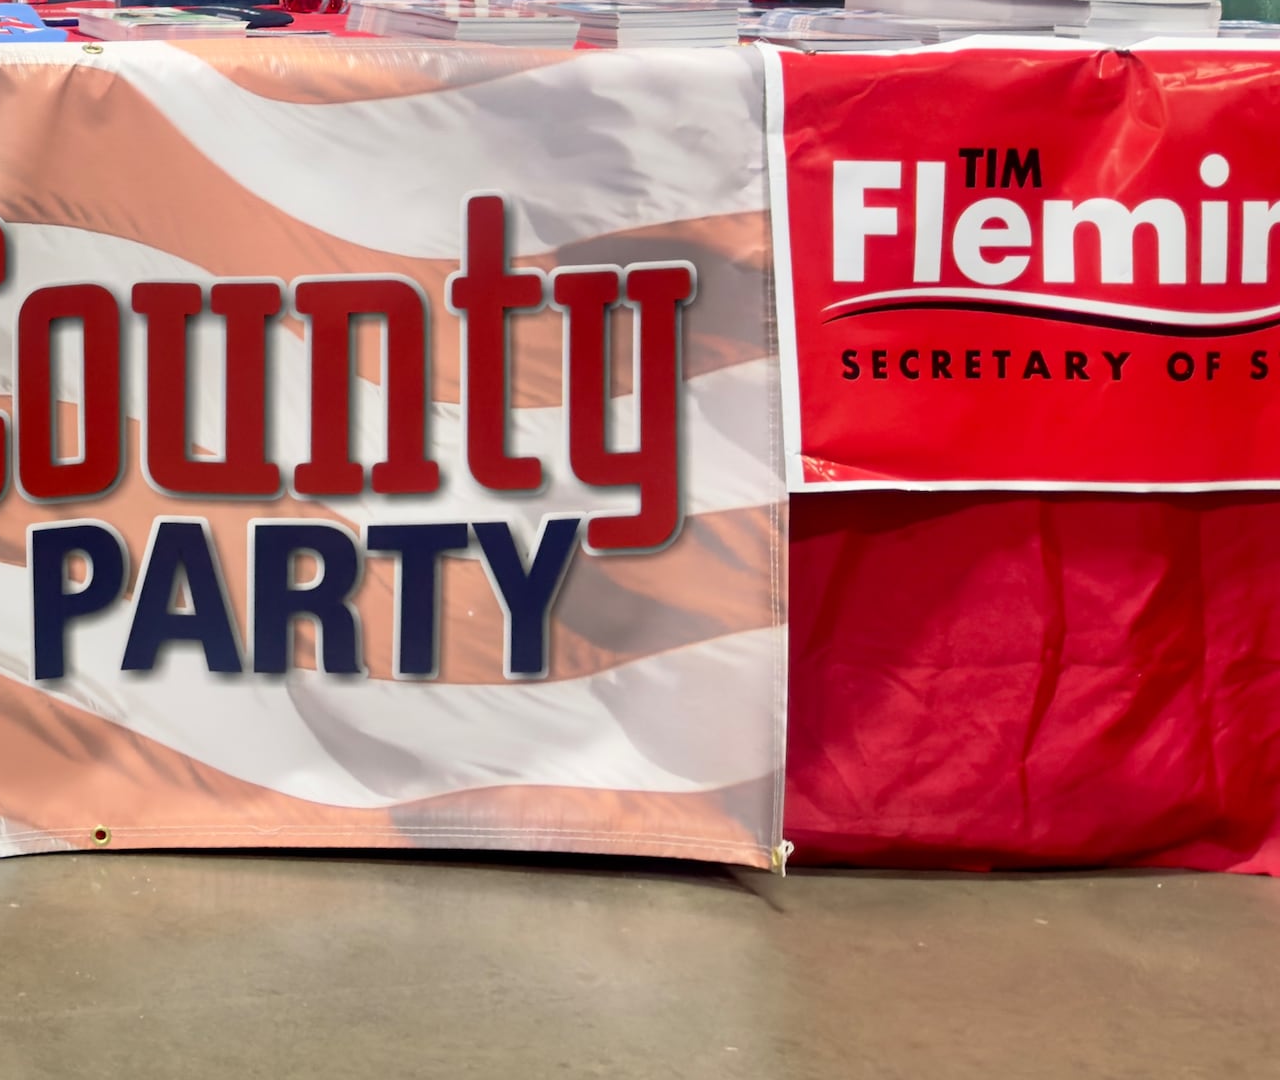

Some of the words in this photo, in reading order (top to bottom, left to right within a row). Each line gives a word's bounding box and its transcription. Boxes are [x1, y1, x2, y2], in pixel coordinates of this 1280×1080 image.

[958, 147, 1042, 189] TIM
[841, 349, 1133, 381] SECRETARY
[1165, 350, 1222, 381] OF
[1249, 350, 1270, 380] S
[30, 517, 583, 680] PARTY
